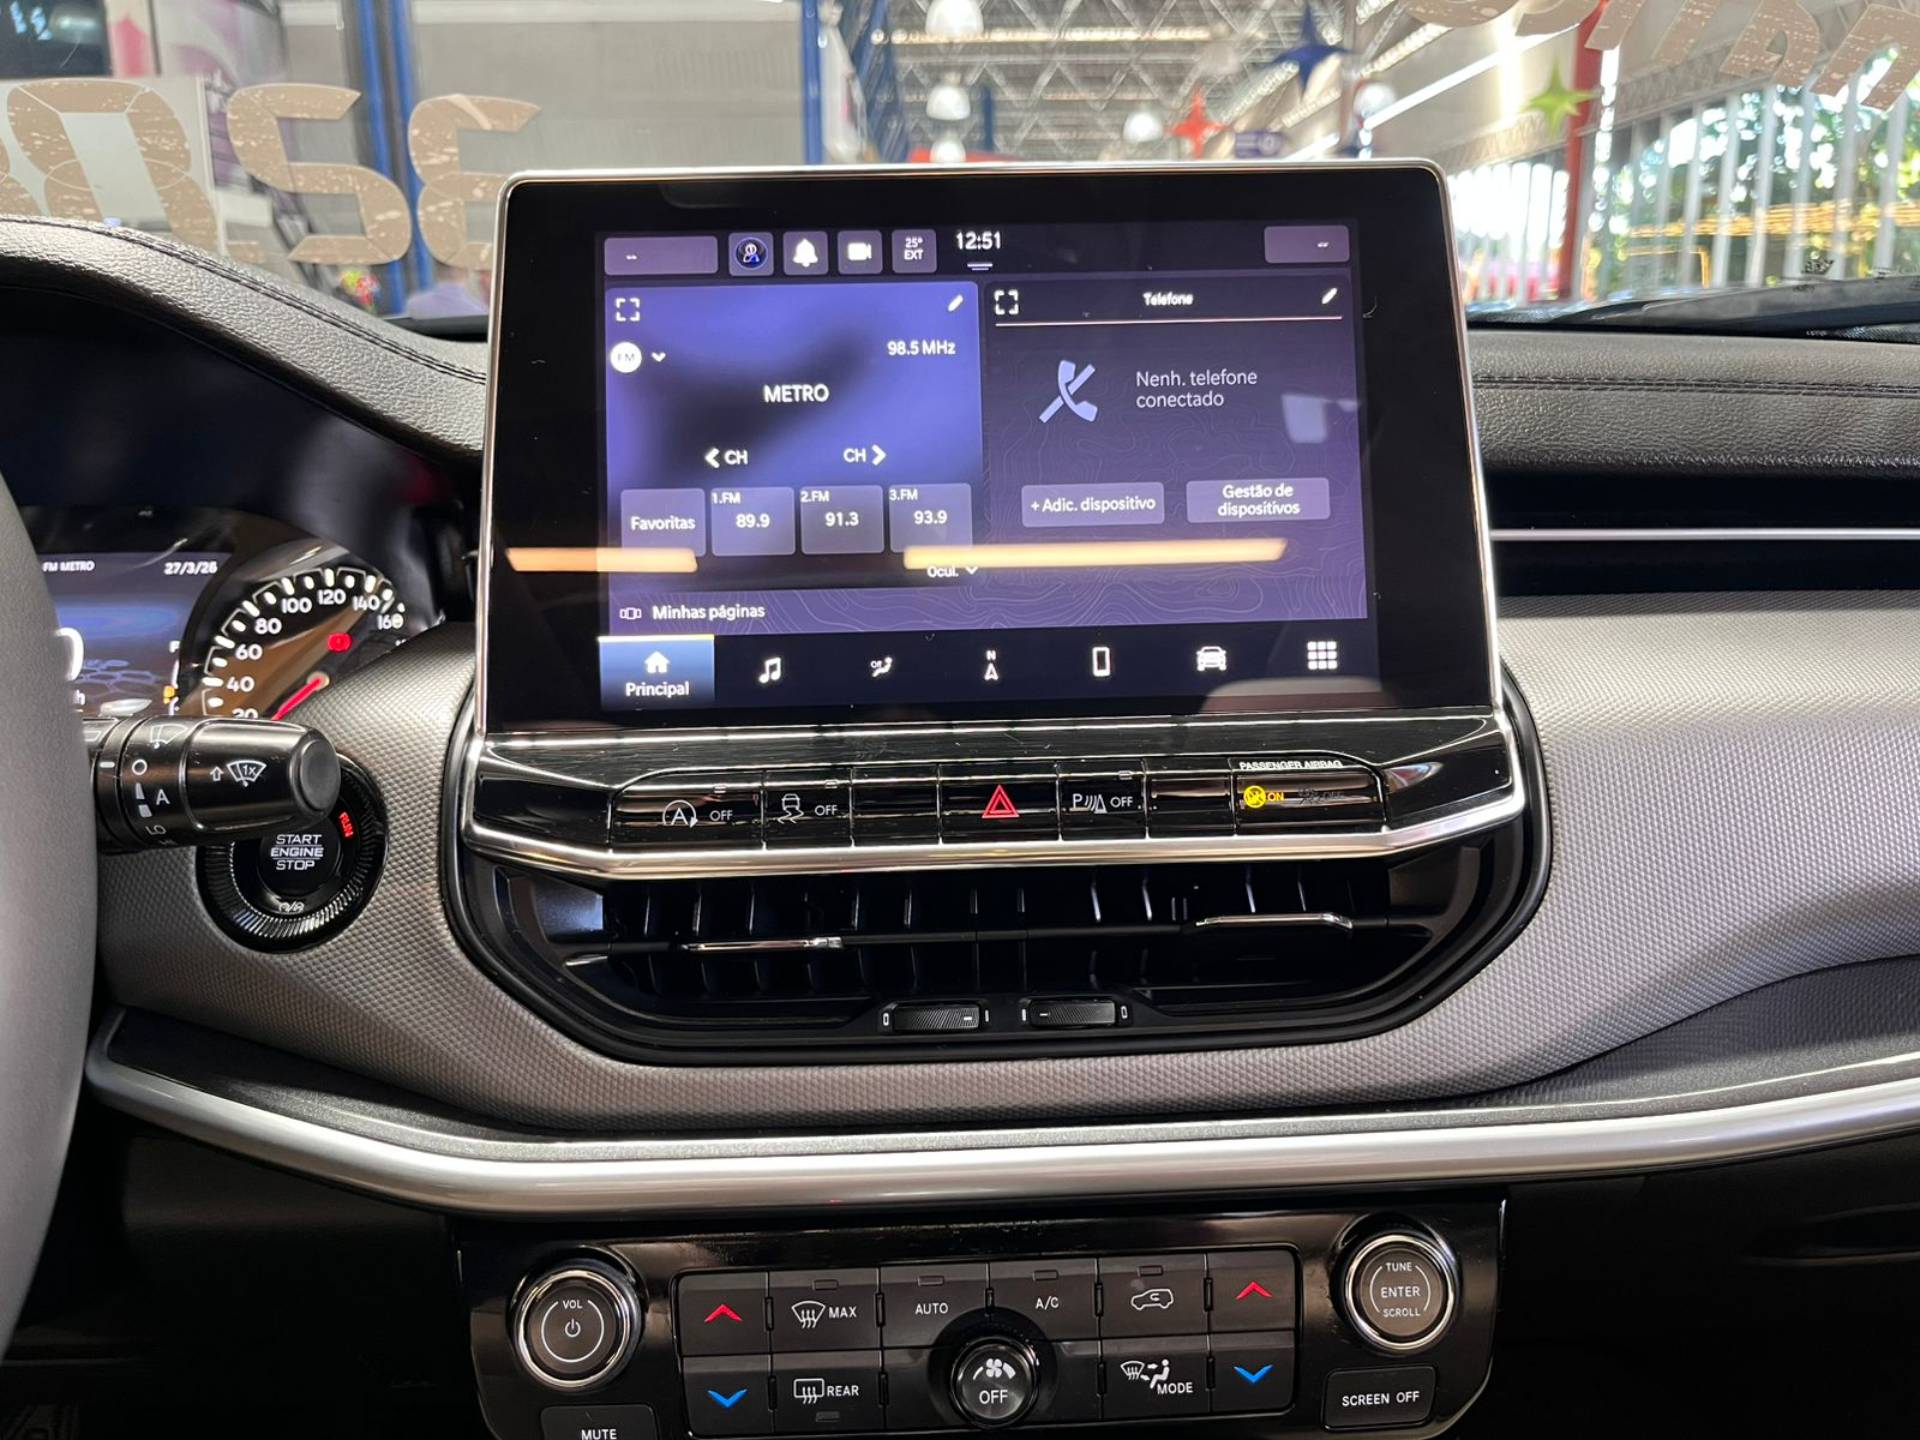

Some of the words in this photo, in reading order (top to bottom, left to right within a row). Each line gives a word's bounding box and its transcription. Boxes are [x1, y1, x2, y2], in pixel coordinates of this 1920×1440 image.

[956, 231, 1001, 250] 12:51
[904, 249, 924, 260] EXT
[1143, 292, 1193, 306] Telefone
[887, 340, 919, 356] 98.5
[922, 340, 956, 355] MHz
[1136, 370, 1186, 387] Nenh.
[1190, 369, 1258, 386] telefone
[764, 384, 829, 403] METRO
[1136, 390, 1224, 409] conectado
[724, 450, 748, 465] CH
[844, 449, 866, 463] CH
[711, 492, 741, 504] 1.FM
[800, 490, 829, 503] 2.FM
[889, 488, 918, 501] 3.FM
[1223, 483, 1272, 499] Gestão
[1274, 484, 1294, 498] de
[1080, 497, 1156, 513] dispositivo
[1218, 501, 1300, 518] dispositivos
[631, 516, 696, 531] Favoritas
[735, 513, 770, 528] 89.9
[825, 511, 859, 527] 91.3
[913, 510, 947, 525] 93.9
[60, 561, 95, 571] METRO
[318, 590, 346, 605] 120
[352, 595, 380, 611] 140
[281, 599, 312, 614] 100
[652, 605, 706, 620] Minhas
[708, 604, 765, 621] páginas
[255, 618, 282, 634] 80
[235, 645, 263, 660] 60
[226, 676, 255, 693] 40
[625, 681, 689, 698] Principal
[1239, 761, 1302, 770] PASSENGER
[1304, 760, 1343, 769] AIRBAG
[156, 788, 171, 805] A
[1111, 796, 1133, 808] OFF
[1267, 792, 1284, 801] ON
[709, 810, 733, 822] OFF
[815, 804, 838, 816] OFF
[276, 834, 323, 845] START
[271, 847, 324, 857] ENGINE
[276, 860, 316, 870] STOP
[1386, 1262, 1413, 1272] TUNE
[1380, 1287, 1421, 1299] ENTER
[562, 1300, 583, 1310] VOL
[915, 1302, 949, 1315] AUTO
[1035, 1296, 1059, 1310] A/C
[829, 1306, 857, 1318] MAX
[1382, 1307, 1421, 1318] SCROLL
[827, 1385, 859, 1397] REAR
[1157, 1382, 1193, 1395] MODE
[979, 1390, 1008, 1405] OFF
[1342, 1393, 1390, 1407] SCREEN
[1395, 1391, 1420, 1404] OFF
[581, 1429, 617, 1440] MUTE
